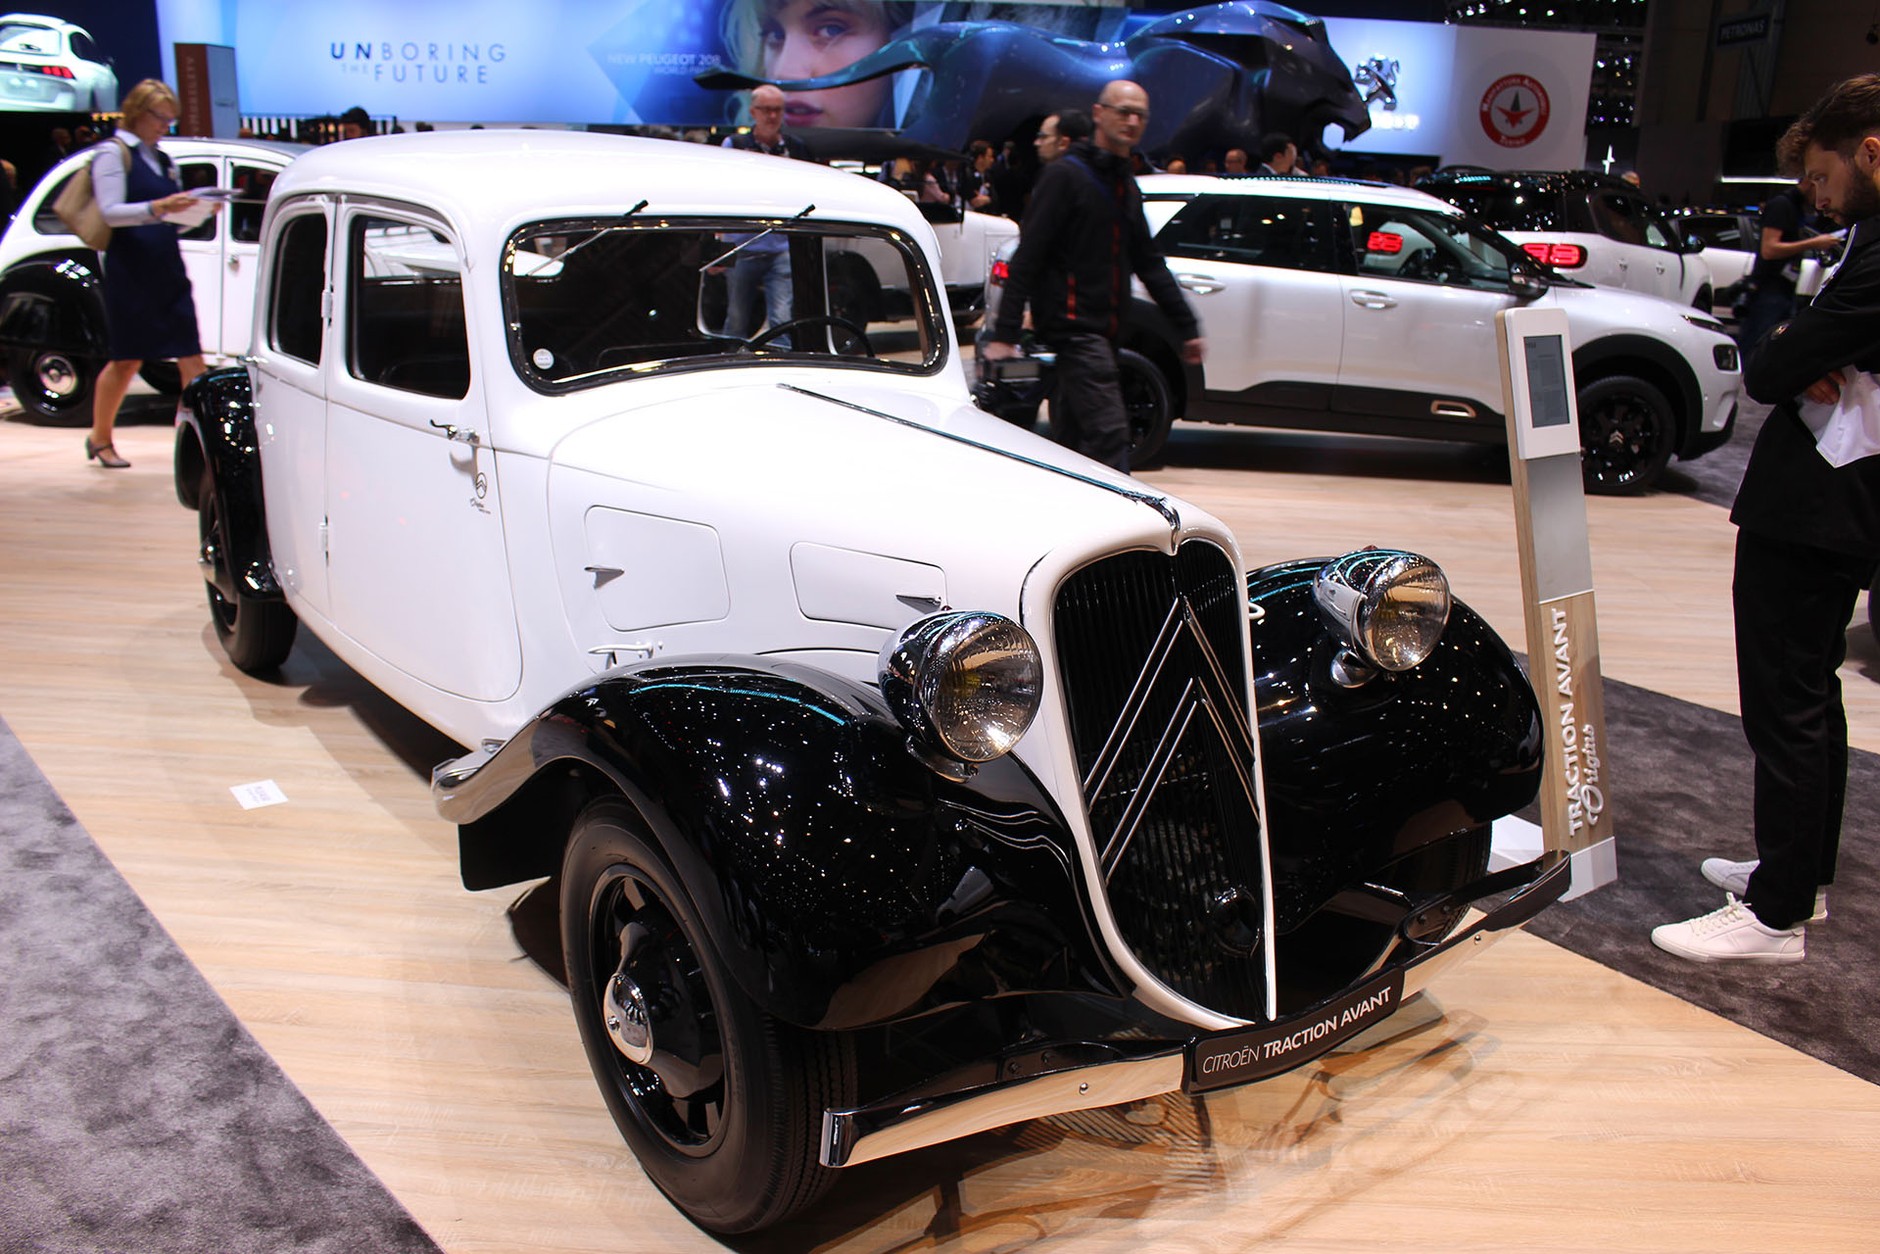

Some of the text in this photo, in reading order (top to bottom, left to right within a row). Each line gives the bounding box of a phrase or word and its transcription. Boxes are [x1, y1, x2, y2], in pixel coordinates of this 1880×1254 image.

[330, 42, 506, 62] UNBORING
[374, 64, 487, 84] FUTURE
[639, 54, 696, 65] PEUGEOT
[1552, 607, 1583, 836] TRACTION AVANT
[1580, 724, 1604, 826] Origins
[1202, 986, 1391, 1074] CITROËN TRACTION AVANT
